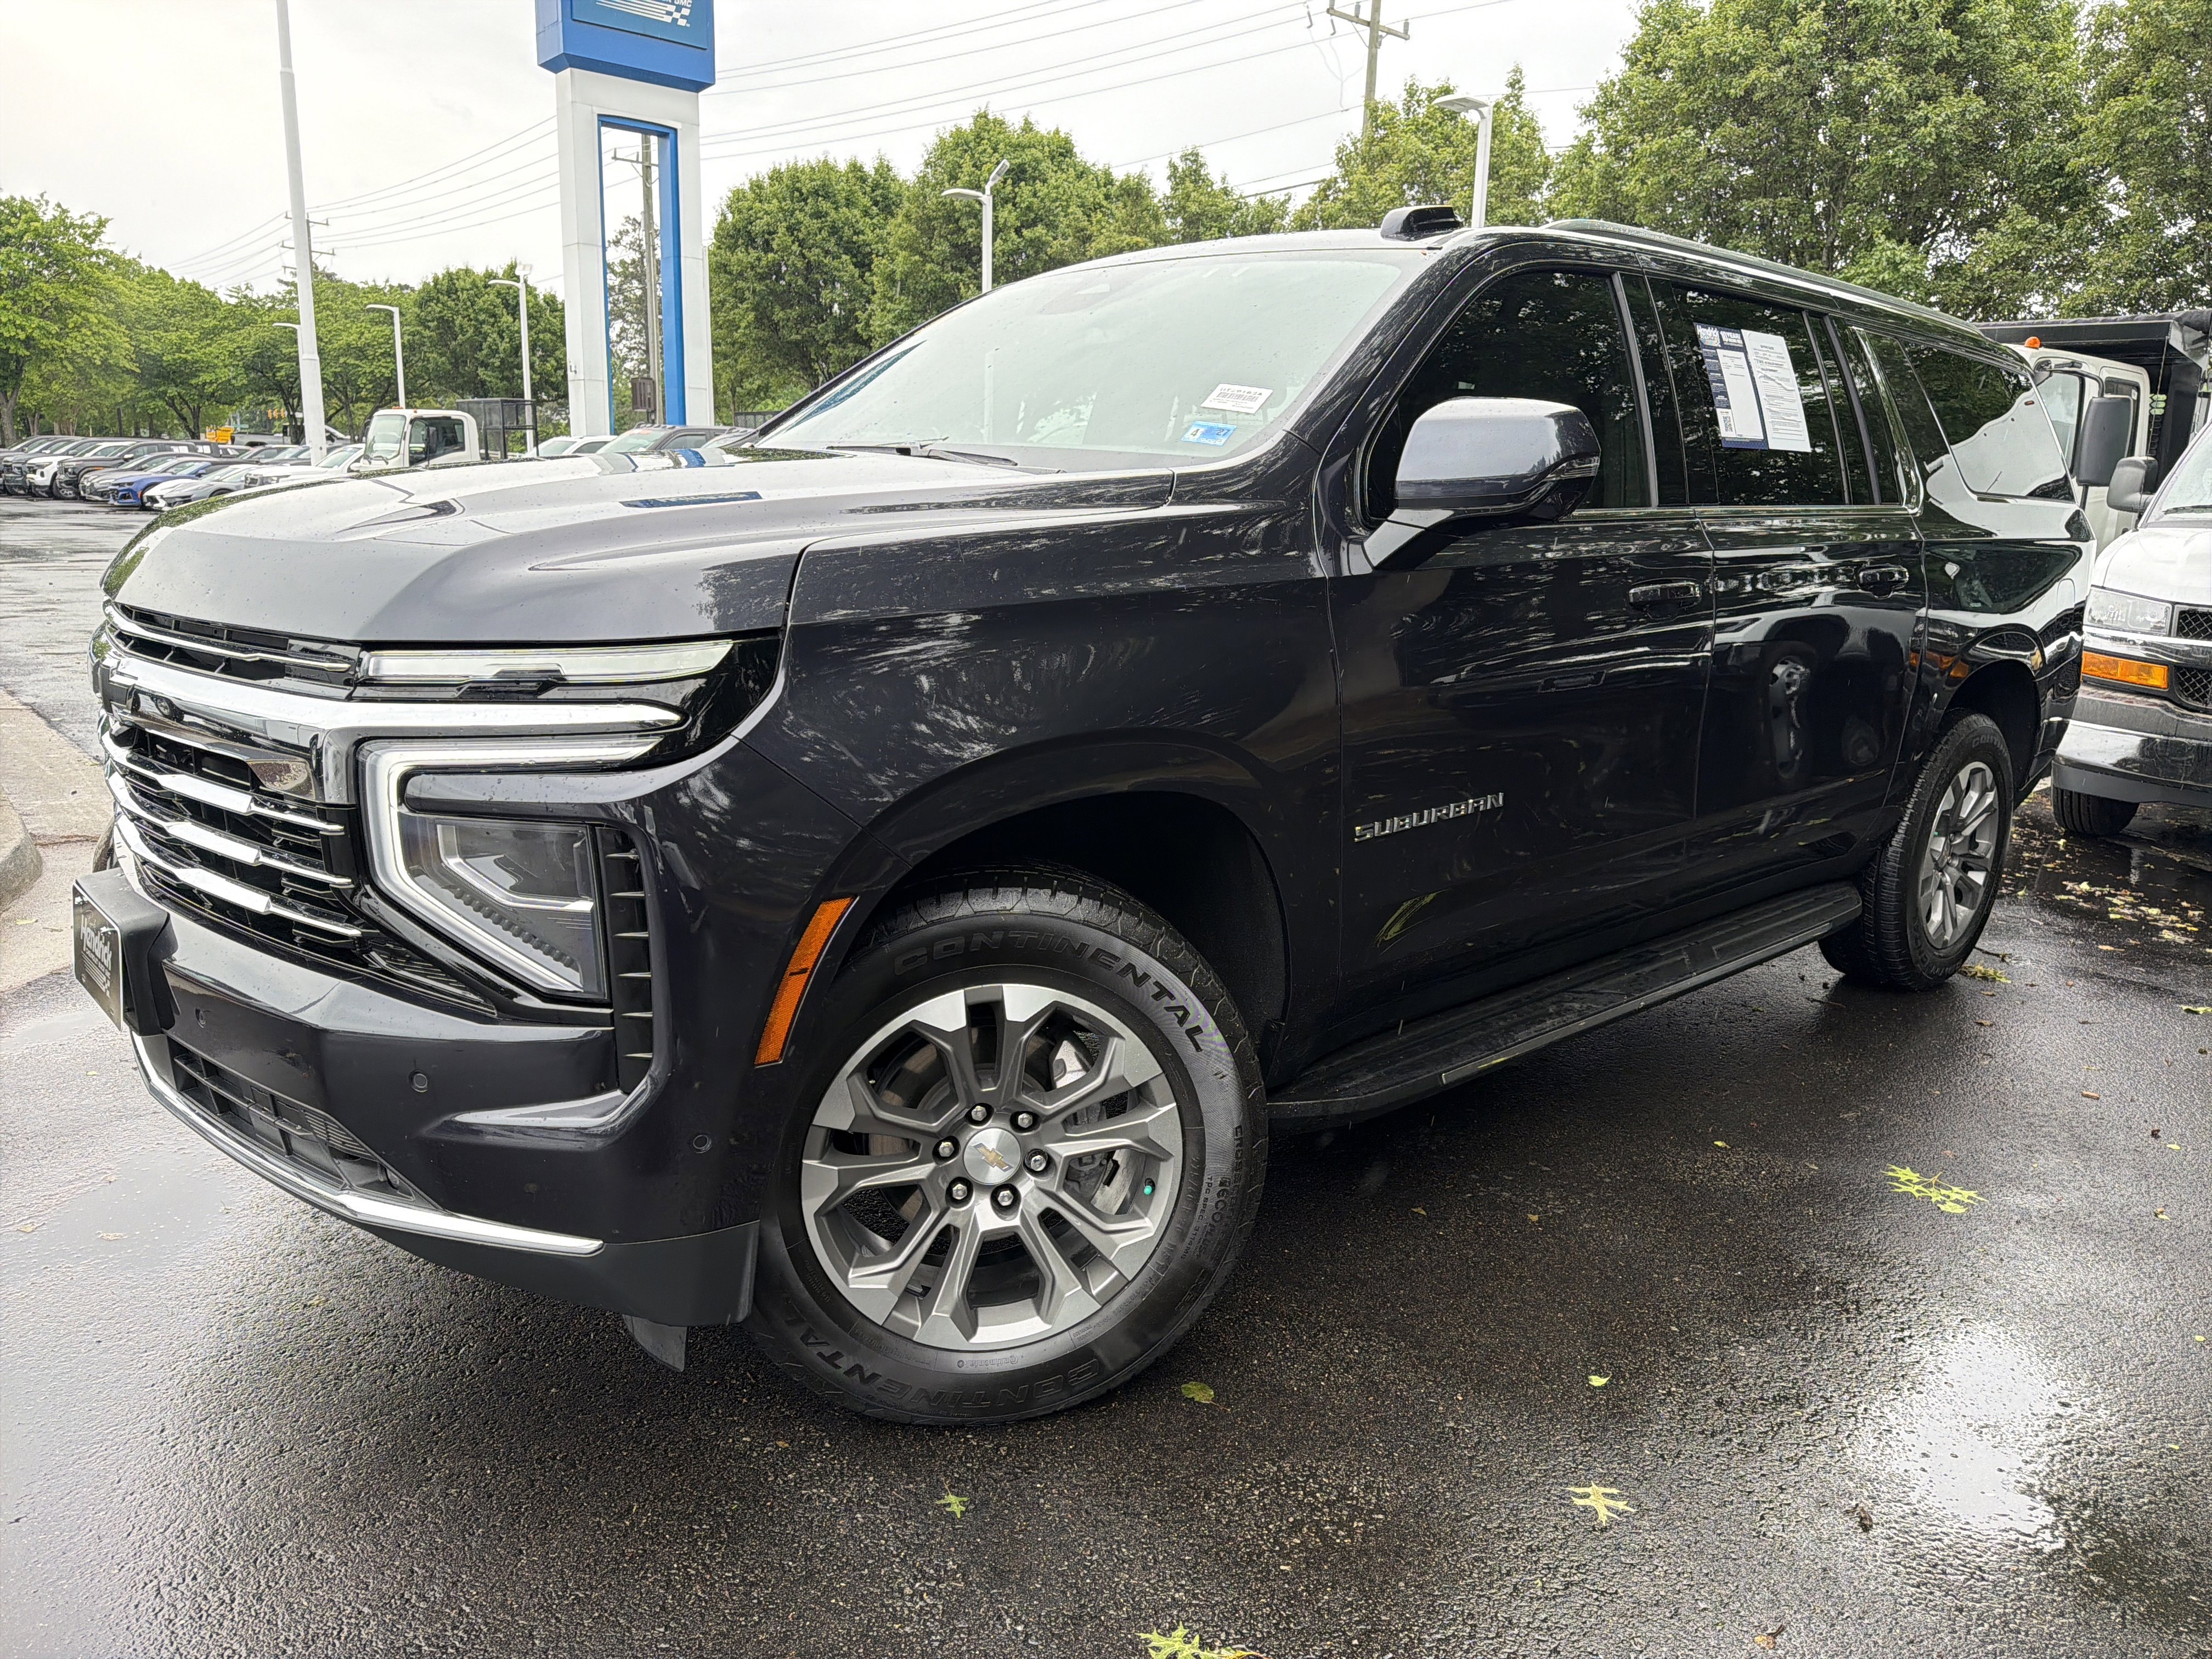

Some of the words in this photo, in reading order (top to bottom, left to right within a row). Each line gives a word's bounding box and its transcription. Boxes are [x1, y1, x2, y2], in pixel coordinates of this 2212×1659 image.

[1190, 428, 1200, 437] 4
[1216, 427, 1231, 436] 27
[1354, 792, 1504, 843] SUBURBAN
[81, 914, 112, 970] Hendrick
[894, 930, 1204, 1052] CONTINENTAL
[785, 1298, 1100, 1409] CONTINENTAL
